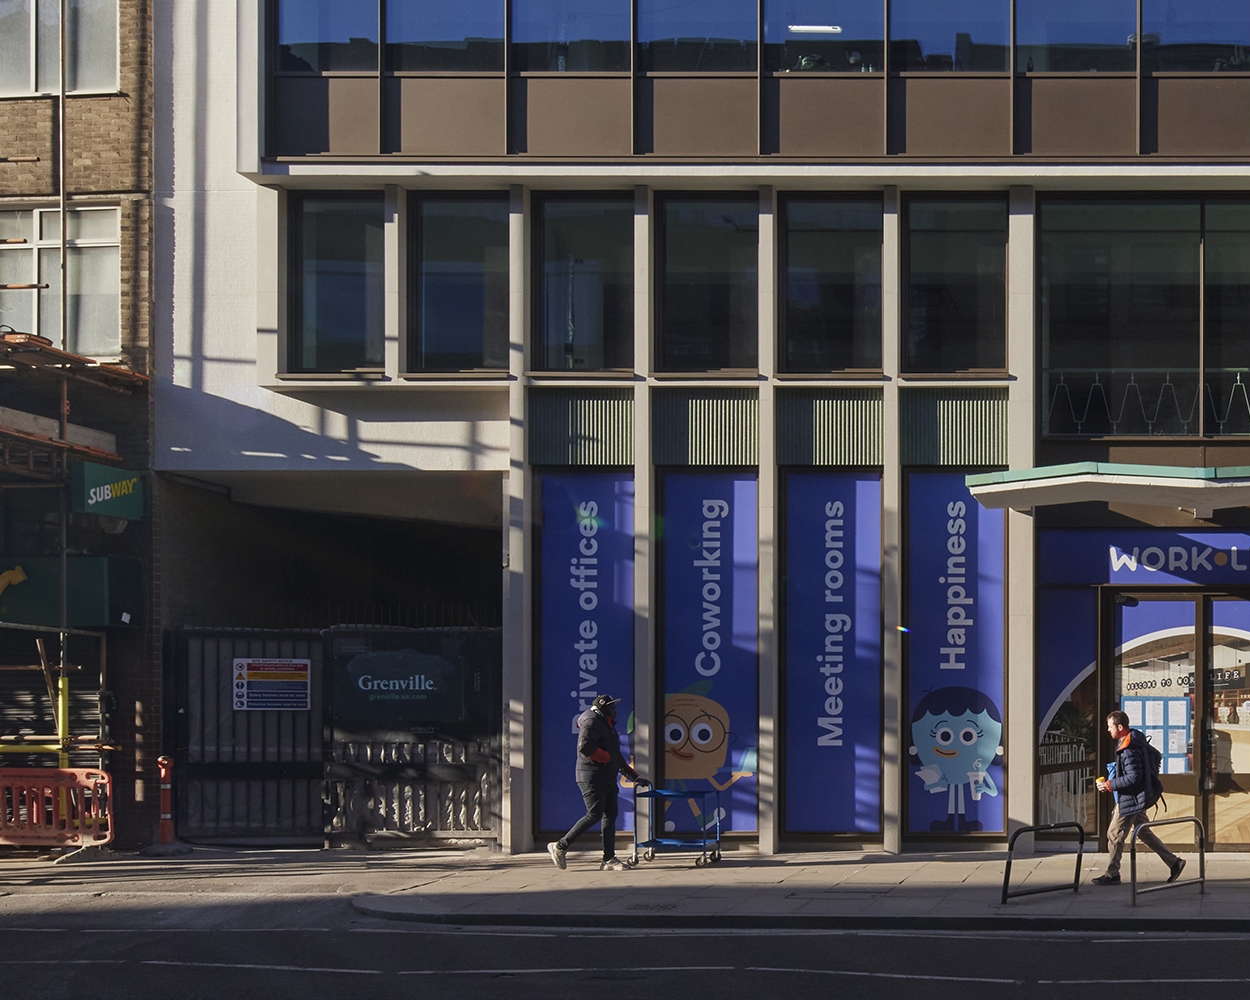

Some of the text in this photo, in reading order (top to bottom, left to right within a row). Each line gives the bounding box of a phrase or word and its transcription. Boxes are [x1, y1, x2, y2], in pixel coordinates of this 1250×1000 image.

[88, 478, 138, 506] SUBWAY
[570, 500, 598, 611] offices
[693, 499, 730, 677] Coworking
[938, 500, 973, 669] Happiness
[816, 500, 852, 747] Meeting rooms
[369, 693, 427, 701] grenville.uk.com
[1126, 680, 1157, 690] WELCOME
[1161, 678, 1172, 687] TO
